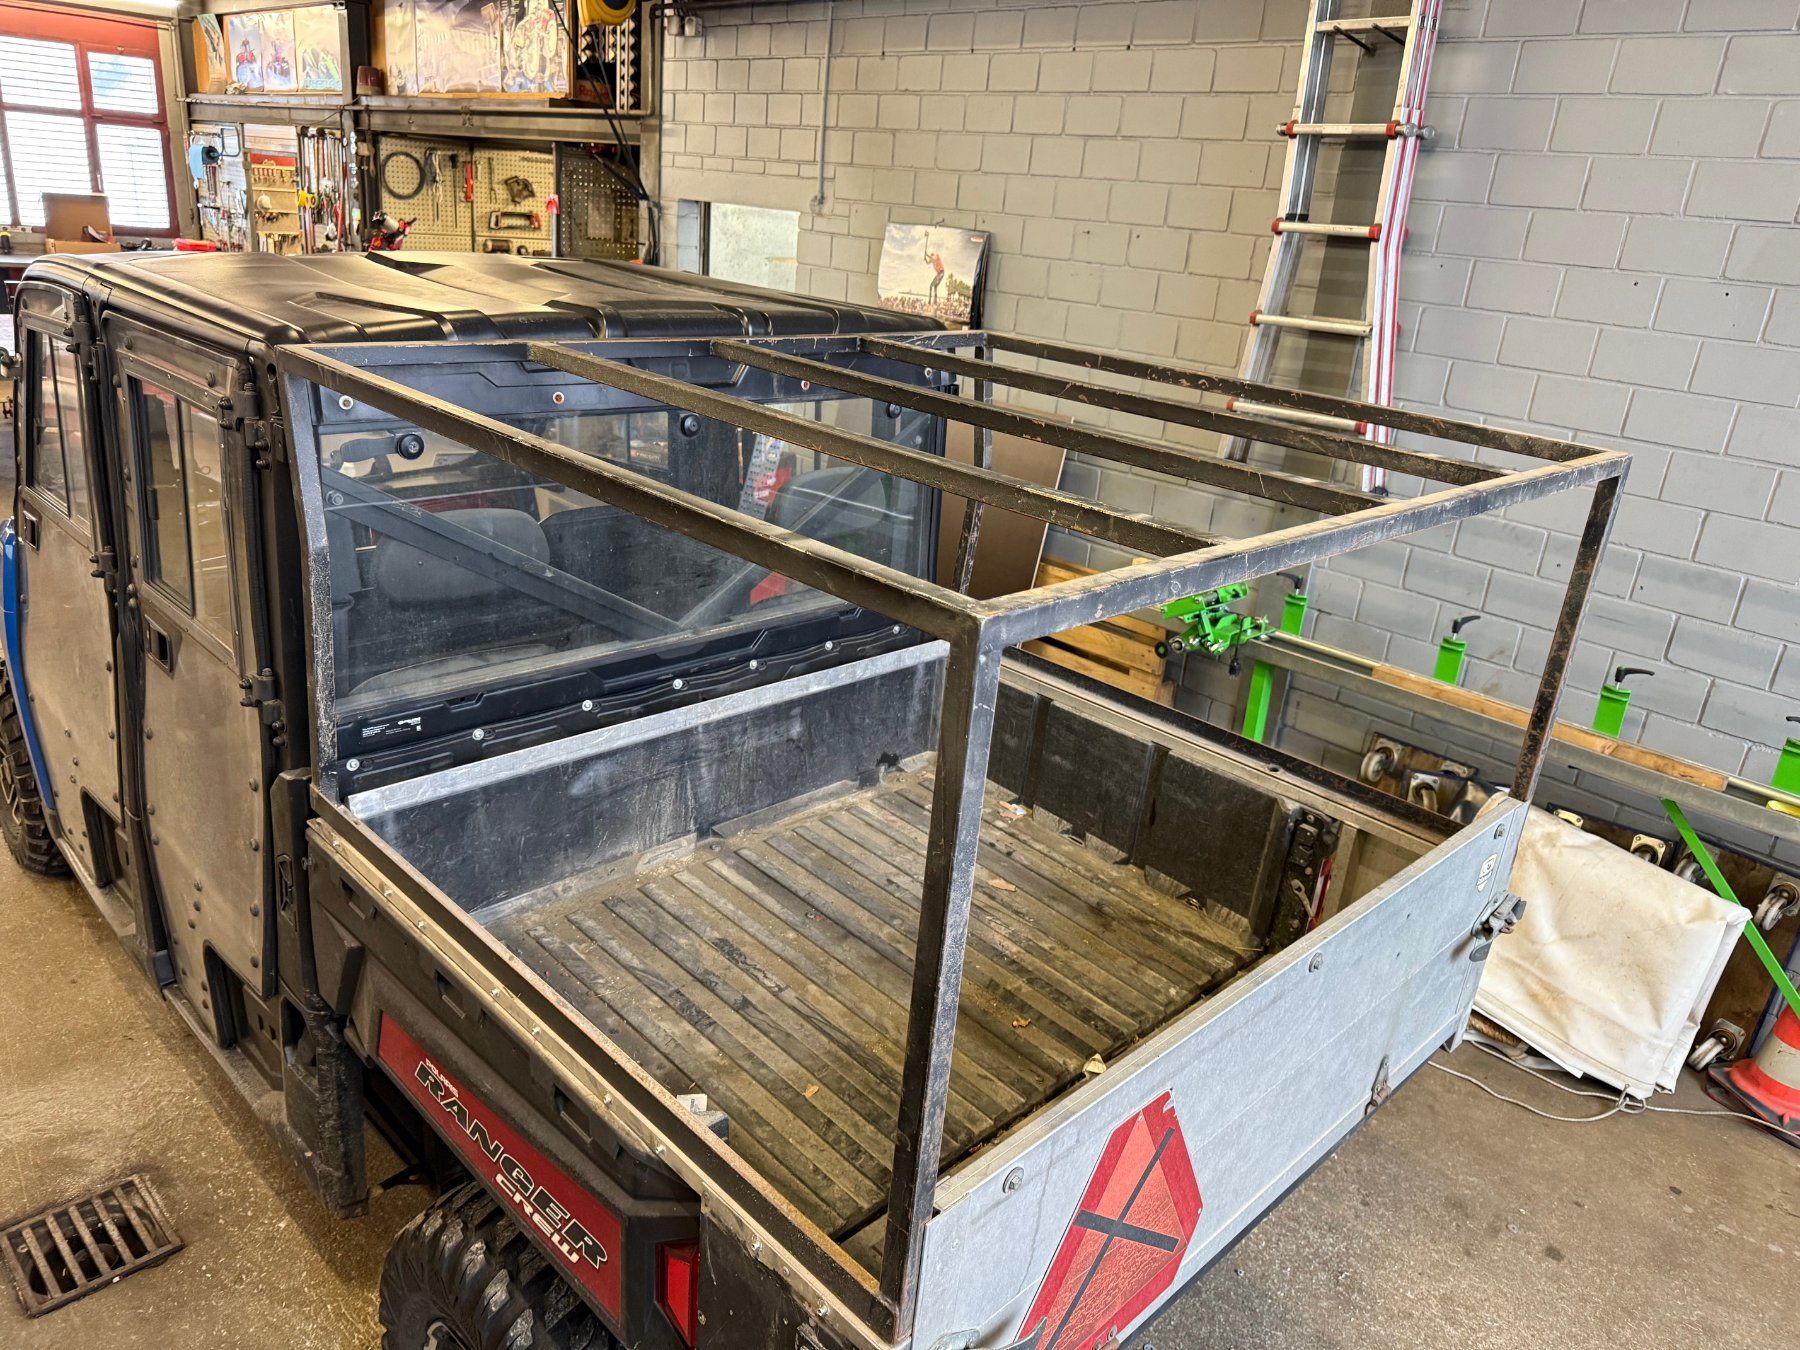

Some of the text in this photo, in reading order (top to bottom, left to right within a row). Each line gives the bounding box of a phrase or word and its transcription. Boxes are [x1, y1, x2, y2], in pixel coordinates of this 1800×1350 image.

[425, 1057, 459, 1098] POLARIS
[414, 1060, 608, 1270] RANGER
[495, 1173, 580, 1264] CREW
